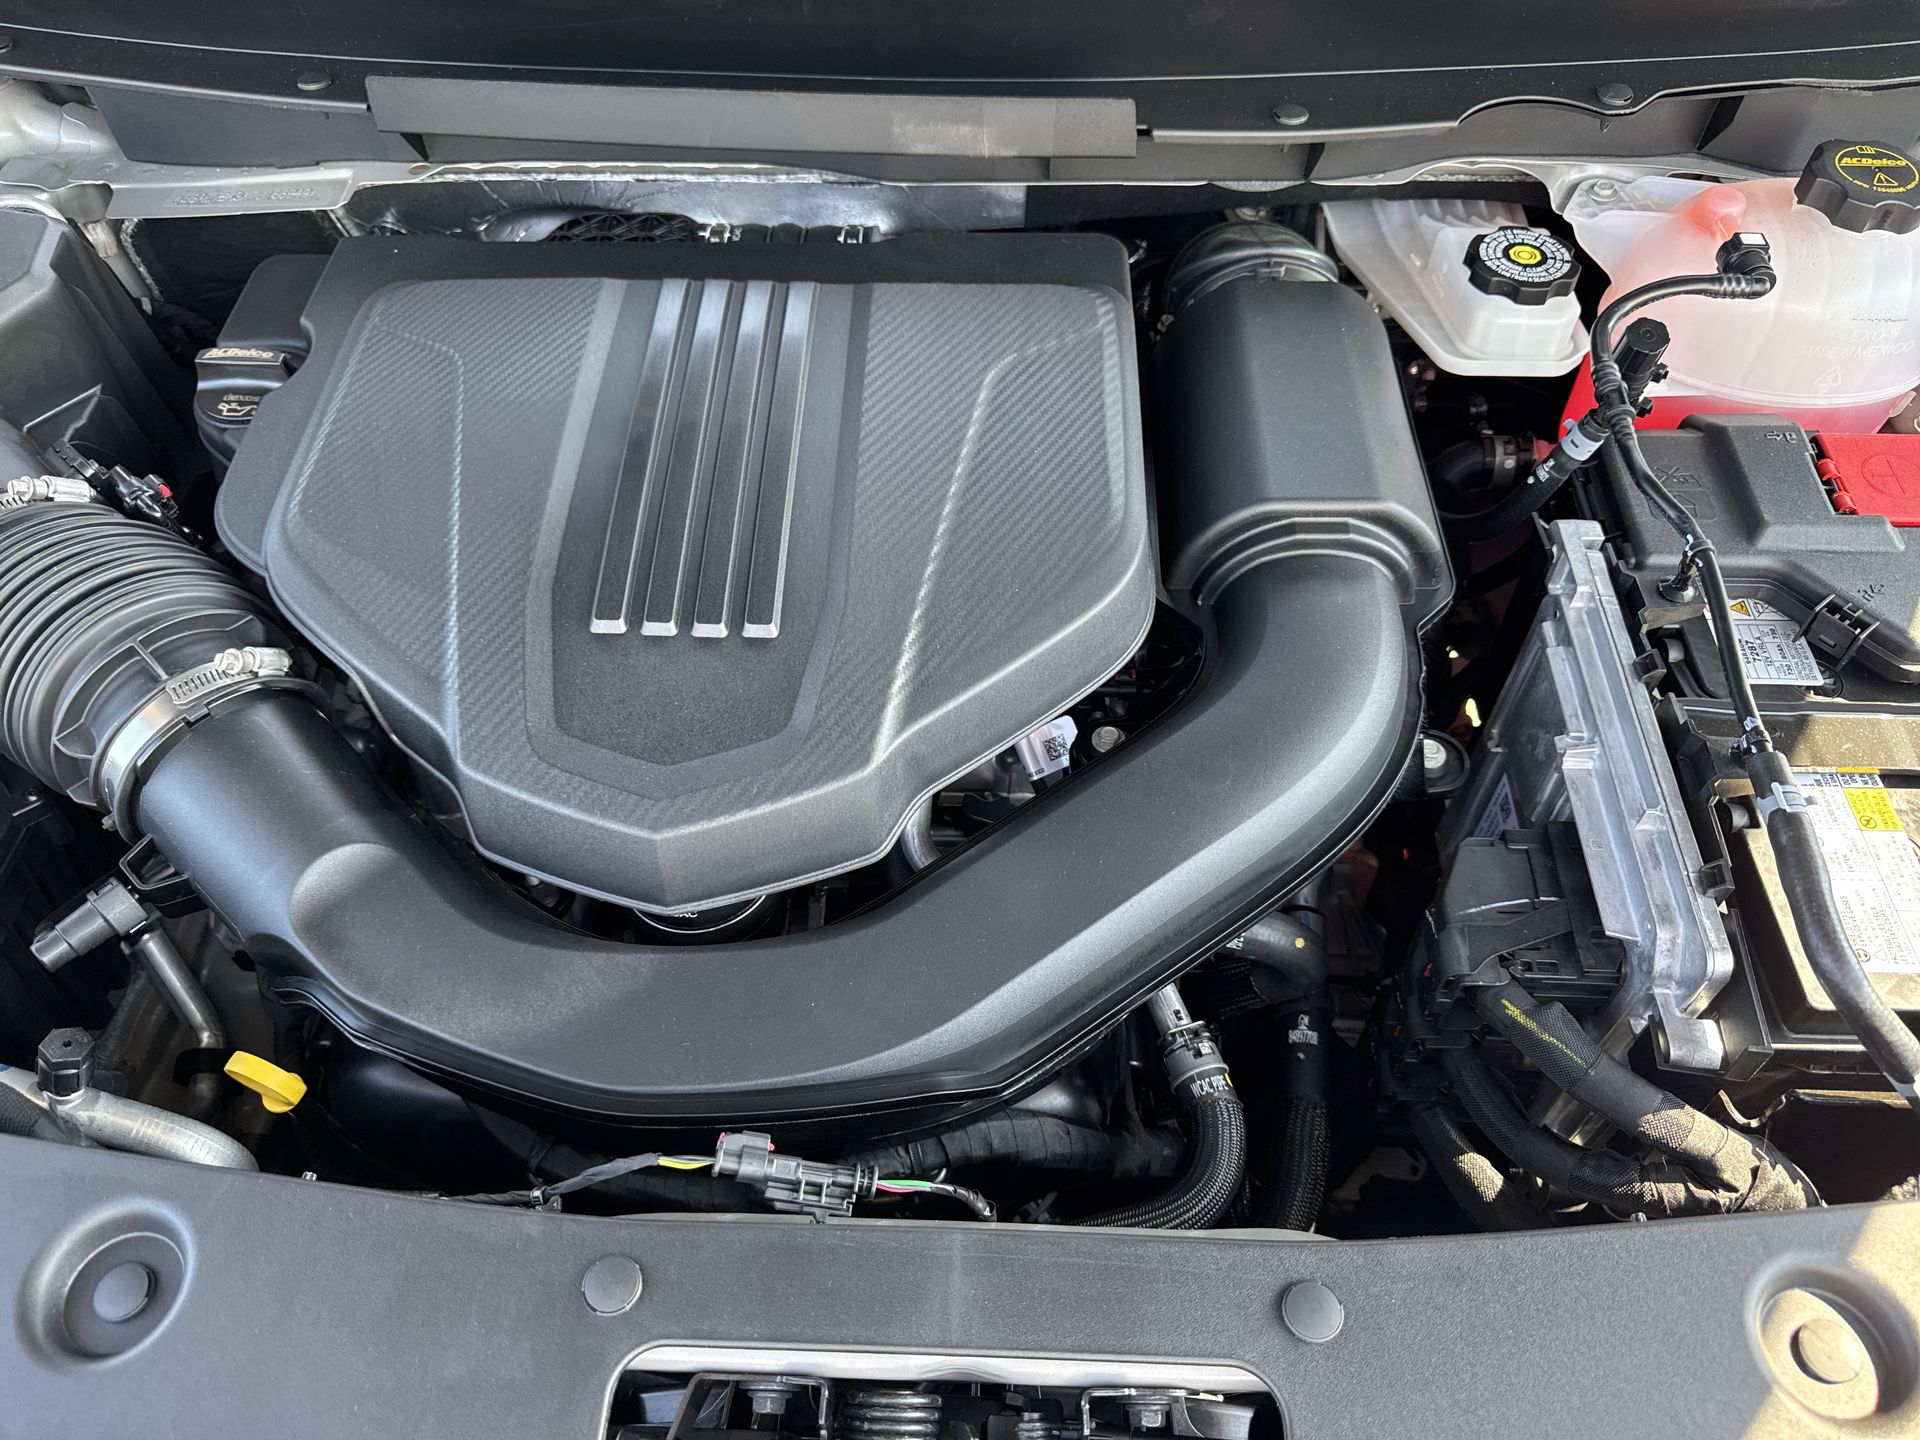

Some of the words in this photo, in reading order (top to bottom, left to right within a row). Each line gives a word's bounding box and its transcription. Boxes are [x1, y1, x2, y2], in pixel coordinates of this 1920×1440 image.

[1840, 157, 1907, 166] ACDelco
[204, 348, 274, 358] ACDelco
[1854, 339, 1915, 360] MEXICO
[1768, 628, 1779, 639] 730
[1744, 640, 1762, 662] 7287
[1775, 643, 1787, 659] 80Ah
[1784, 663, 1794, 675] 730
